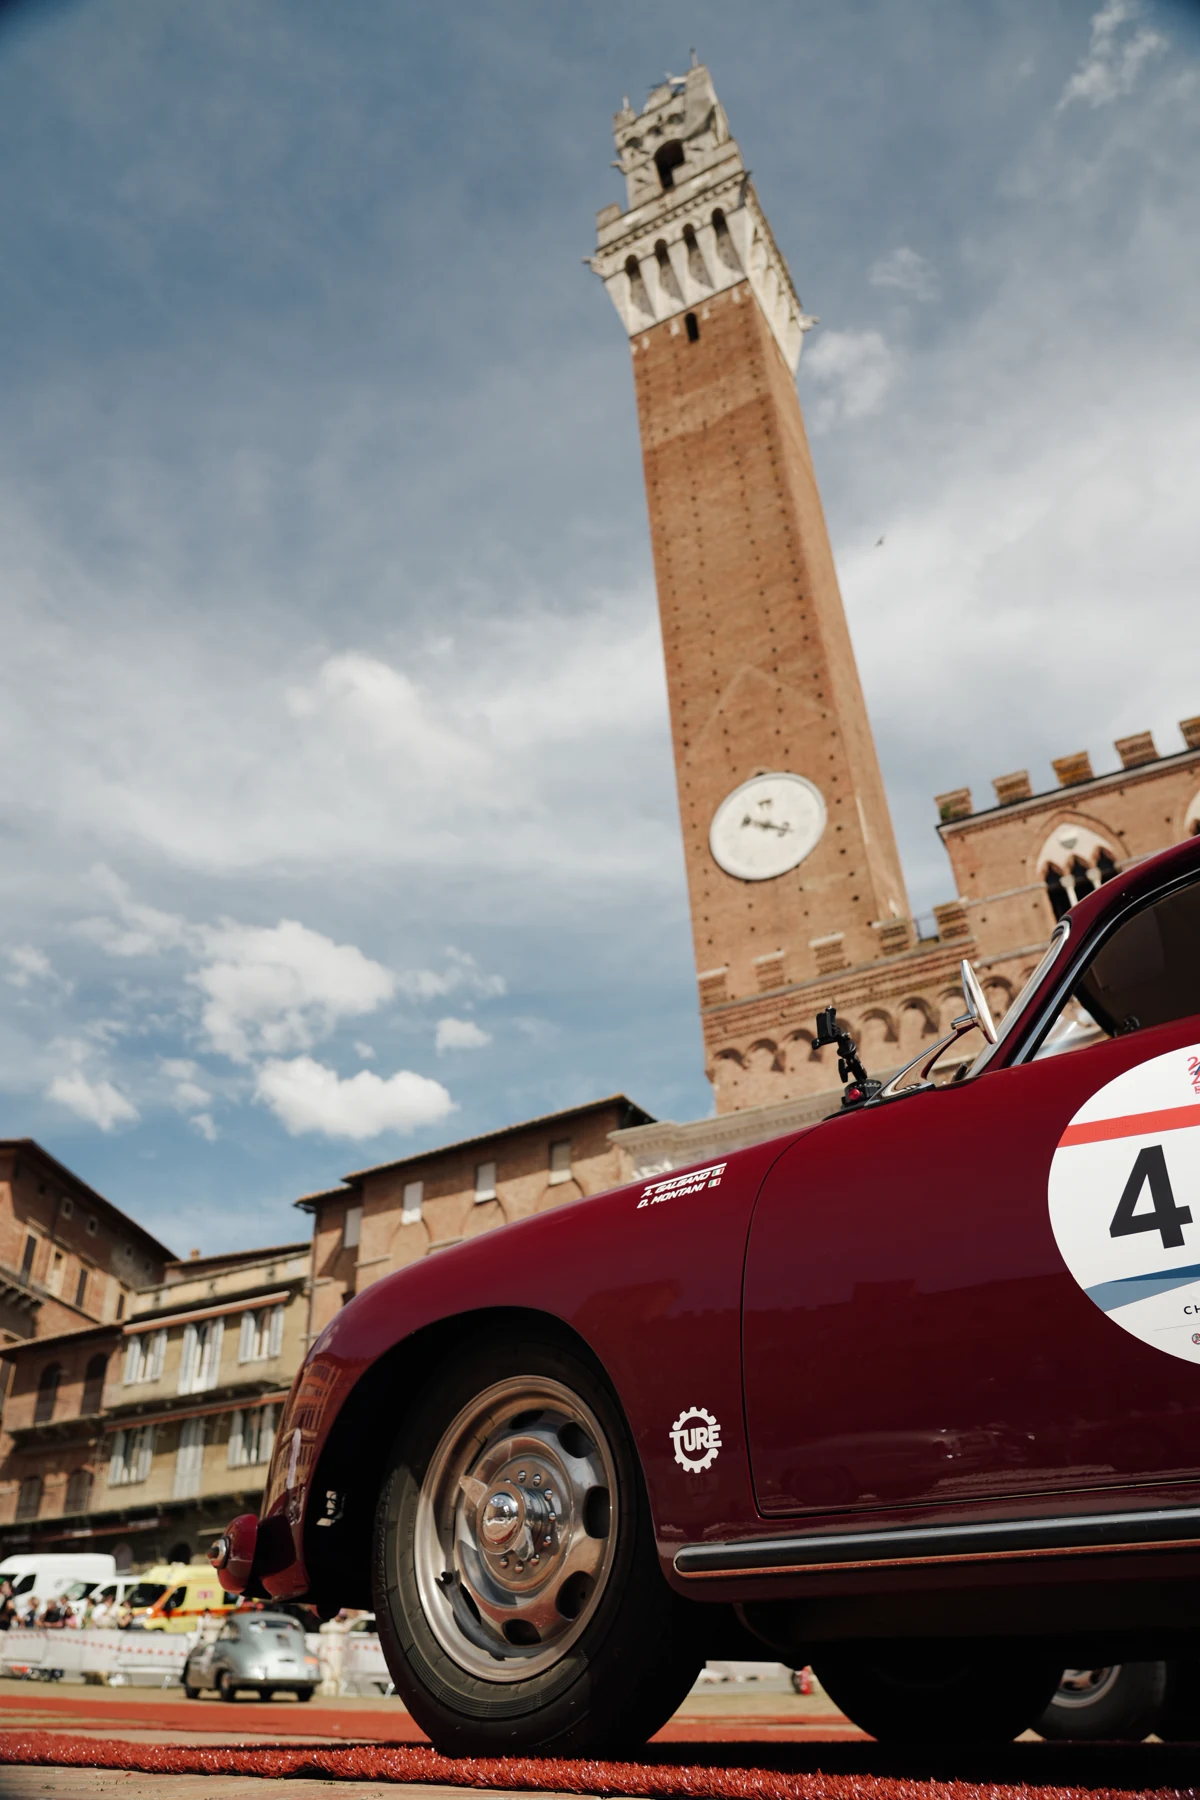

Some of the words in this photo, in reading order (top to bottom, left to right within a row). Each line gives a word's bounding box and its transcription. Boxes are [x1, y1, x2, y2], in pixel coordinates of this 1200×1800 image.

[637, 1199, 648, 1209] D.
[650, 1182, 706, 1205] MONTANI
[1109, 1144, 1193, 1249] 4
[669, 1424, 722, 1451] TURE
